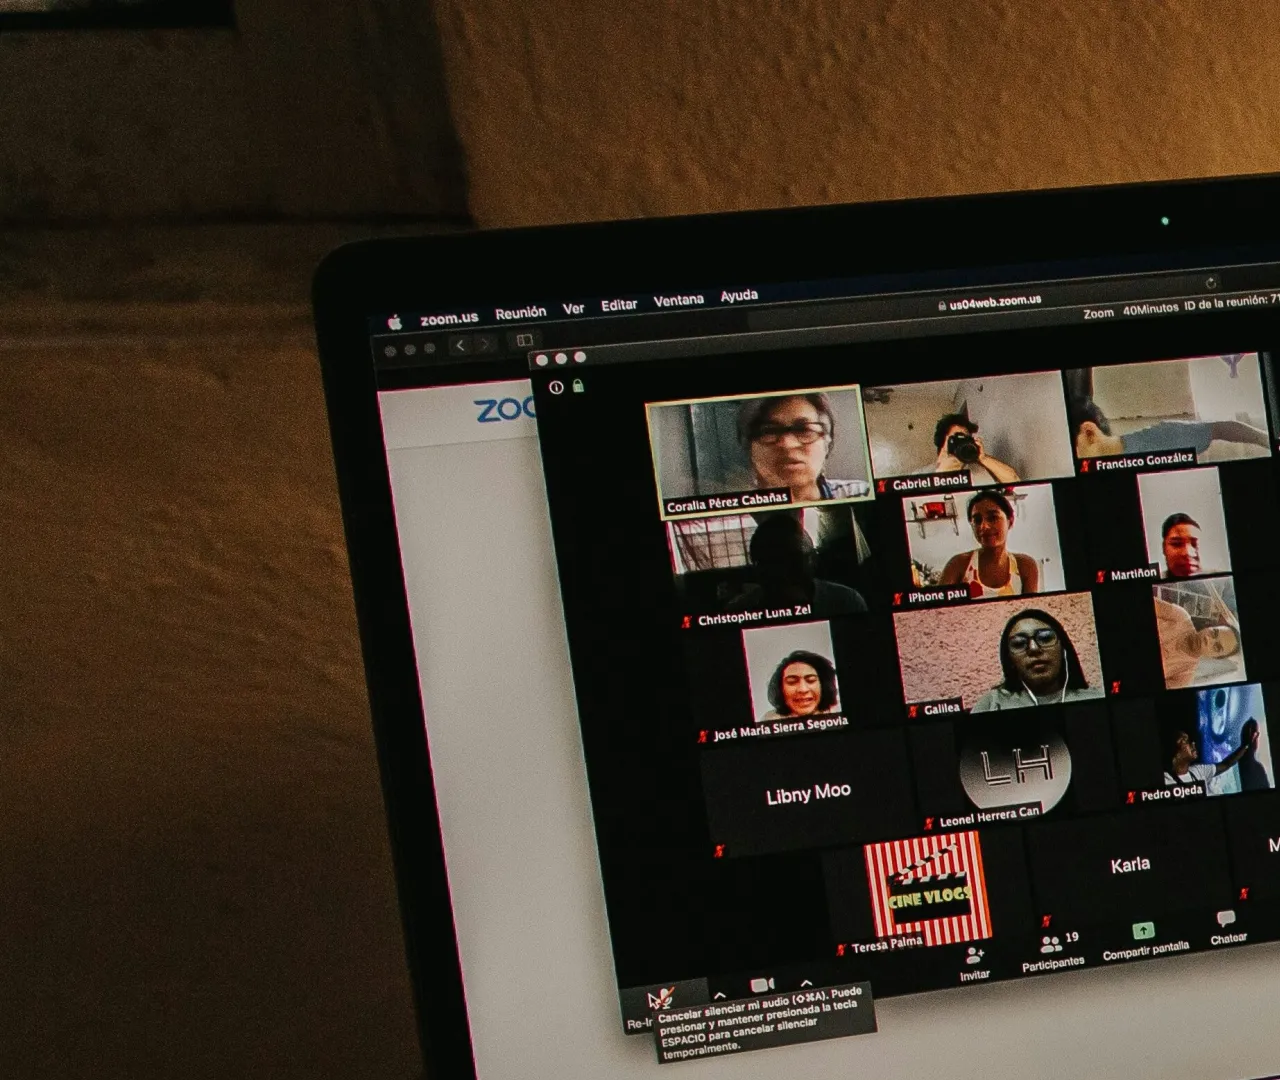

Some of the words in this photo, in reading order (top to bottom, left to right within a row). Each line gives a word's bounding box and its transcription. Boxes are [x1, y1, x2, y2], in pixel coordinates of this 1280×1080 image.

[420, 311, 479, 327] zoom.us
[496, 305, 547, 320] Reunión
[563, 303, 585, 315] Ver
[601, 297, 638, 312] Editar
[654, 293, 705, 308] Ventana
[721, 288, 759, 304] Ayuda
[949, 293, 1042, 311] us04web.zoom.us
[1083, 307, 1115, 320] Zoom
[1123, 302, 1180, 317] 40Minutos
[1184, 299, 1196, 311] ID
[1198, 298, 1212, 310] de
[1214, 298, 1224, 309] la
[1226, 293, 1269, 308] reunión:
[1095, 455, 1144, 471] Francisco
[1147, 451, 1194, 467] González
[893, 477, 931, 491] Gabriel
[933, 473, 969, 488] Benois
[667, 499, 707, 514] Coralia
[708, 495, 739, 510] Pérez
[741, 491, 788, 506] Cabañas
[1111, 565, 1157, 581] Martiñon
[908, 588, 945, 603] iPhone
[947, 587, 968, 602] pau
[698, 608, 763, 627] Christopher
[765, 606, 793, 621] Luna
[795, 604, 812, 617] Zel
[924, 702, 961, 716] Galilea
[713, 728, 738, 743] José
[740, 724, 771, 738] María
[773, 720, 805, 736] Sierra
[806, 715, 849, 731] Segovia
[766, 786, 812, 807] Libny
[815, 782, 852, 800] Moo
[1141, 788, 1170, 802] Pedro
[1171, 784, 1203, 800] Ojeda
[939, 812, 975, 828] Leonel
[977, 808, 1017, 824] Herrera
[1018, 805, 1040, 818] Can
[1110, 856, 1151, 875] Karla
[887, 891, 922, 910] CINE
[851, 940, 889, 955] Teresa
[890, 935, 923, 951] Palma
[1065, 931, 1080, 943] 19
[1210, 931, 1248, 946] Chatear
[1102, 945, 1151, 963] Compartir
[1152, 939, 1190, 957] pantalla
[1022, 955, 1086, 973] Participantes
[959, 968, 991, 982] Invitar
[657, 1009, 703, 1024] Cancelar
[704, 1003, 746, 1018] silenciar
[747, 1001, 760, 1012] mi
[762, 997, 790, 1009] audio
[831, 986, 862, 1000] Puede
[660, 1021, 707, 1037] presionar
[717, 1013, 764, 1029] mantener
[766, 1006, 821, 1023] presionada
[822, 1003, 831, 1013] la
[833, 999, 858, 1011] tecla
[661, 1033, 706, 1048] ESPACIO
[708, 1030, 731, 1044] para
[732, 1023, 775, 1038] cancelar
[777, 1017, 818, 1033] silenciar
[663, 1041, 741, 1060] temporalmente.
